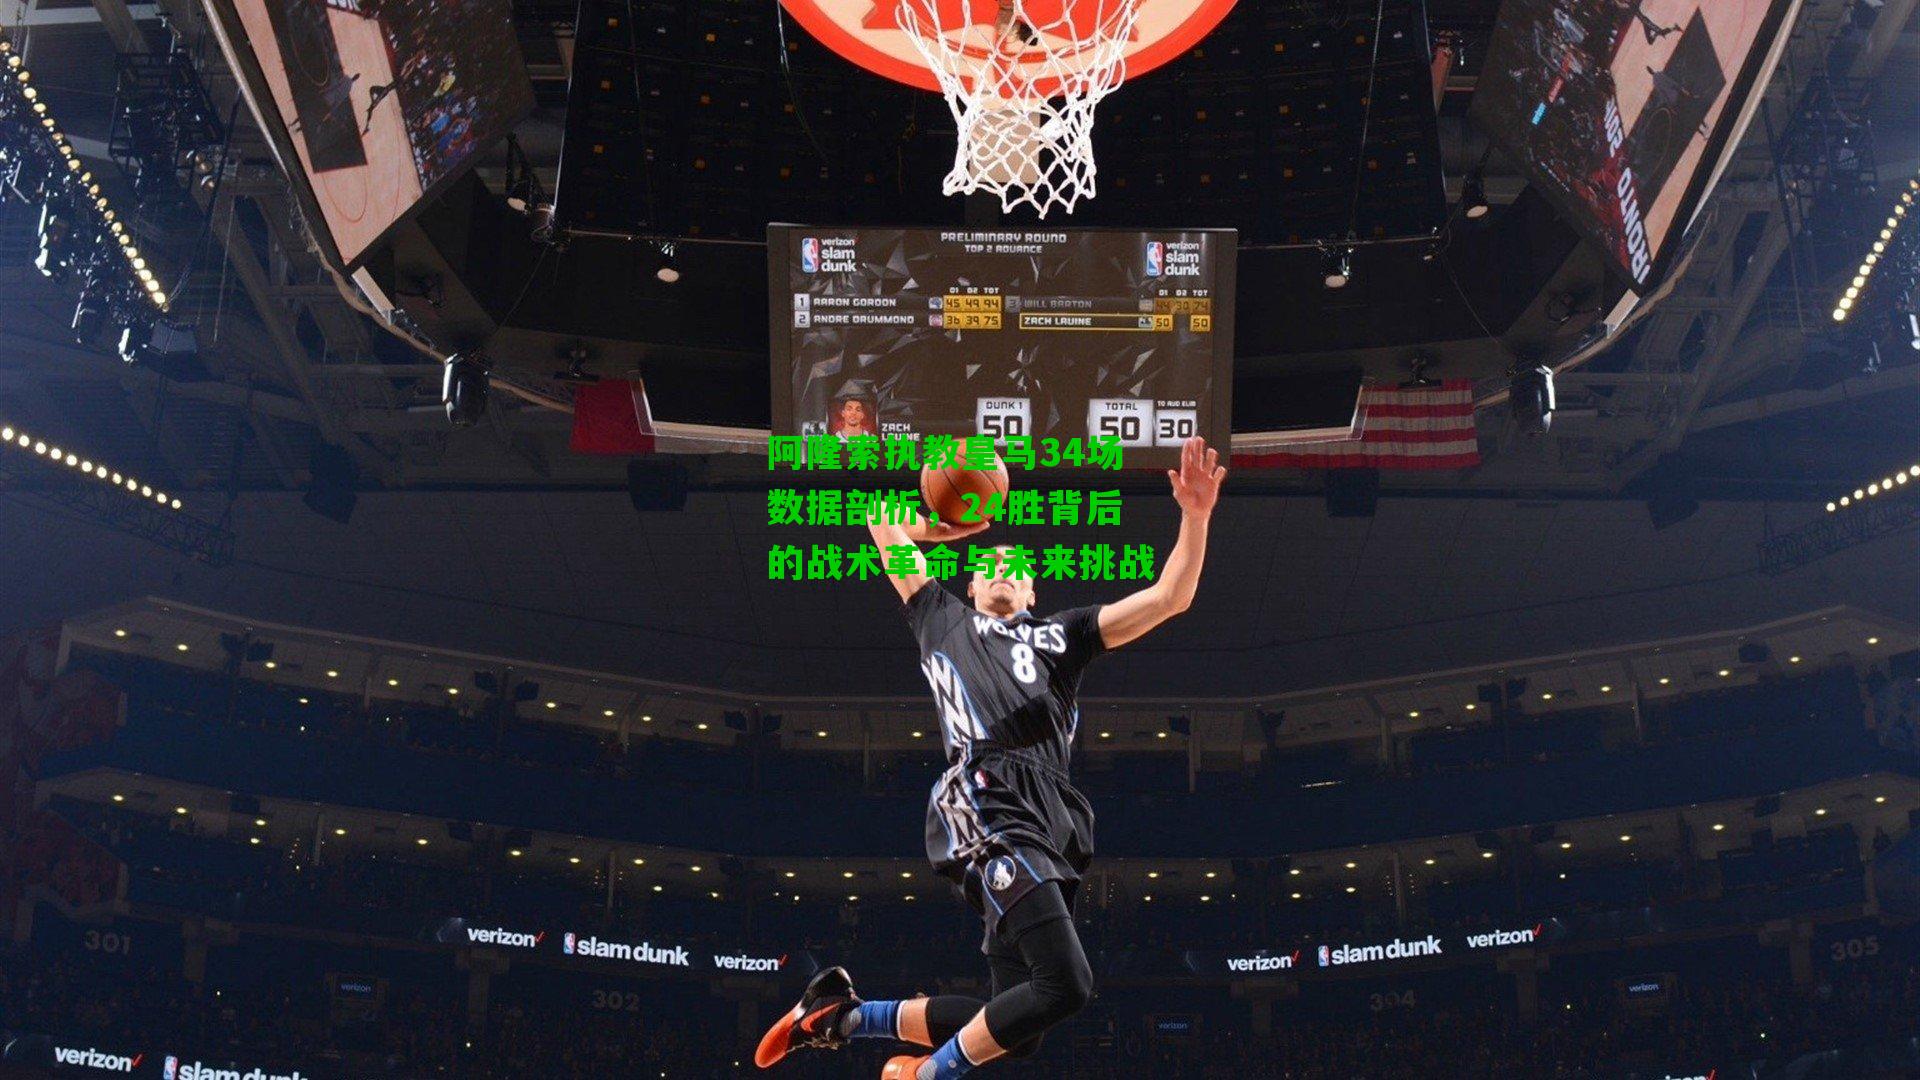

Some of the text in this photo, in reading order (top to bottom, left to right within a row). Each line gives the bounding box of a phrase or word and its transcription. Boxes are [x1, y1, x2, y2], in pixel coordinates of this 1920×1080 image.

[821, 238, 855, 246] verizon
[941, 232, 1067, 244] PRELIMINARY ROUND
[965, 244, 1043, 255] TOP 2 ADVANCE
[1166, 242, 1199, 251] verizon
[821, 246, 856, 260] slam
[1165, 250, 1200, 264] slam
[821, 260, 857, 272] dunk
[1165, 264, 1200, 276] dunk
[813, 298, 850, 307] AARON
[853, 298, 896, 307] GORDON
[946, 299, 960, 309] 45
[965, 299, 980, 309] 49
[983, 299, 999, 309] 94
[1050, 300, 1092, 308] BARTON
[813, 315, 849, 324] ANDRE
[852, 315, 915, 325] DRUMMOND
[965, 315, 980, 326] 39
[984, 315, 999, 326] 75
[1024, 317, 1052, 325] ZACH
[1156, 318, 1170, 327] 50
[1193, 318, 1208, 327] 50
[986, 401, 1023, 410] DUNK 1
[1105, 402, 1138, 411] TOTAL
[881, 423, 911, 432] ZACH
[983, 415, 1023, 438] 50
[1100, 416, 1141, 441] 50
[1160, 418, 1193, 438] 30
[881, 433, 920, 441] LVNE
[1011, 642, 1037, 684] 8
[467, 927, 535, 947] verizon
[1467, 926, 1533, 948] verizon
[577, 936, 689, 966] slam dunk
[1331, 934, 1442, 966] slam dunk
[714, 953, 778, 971] verizon
[1227, 951, 1292, 972] verizon
[1628, 982, 1660, 993] verizon
[55, 1047, 132, 1072] verizon
